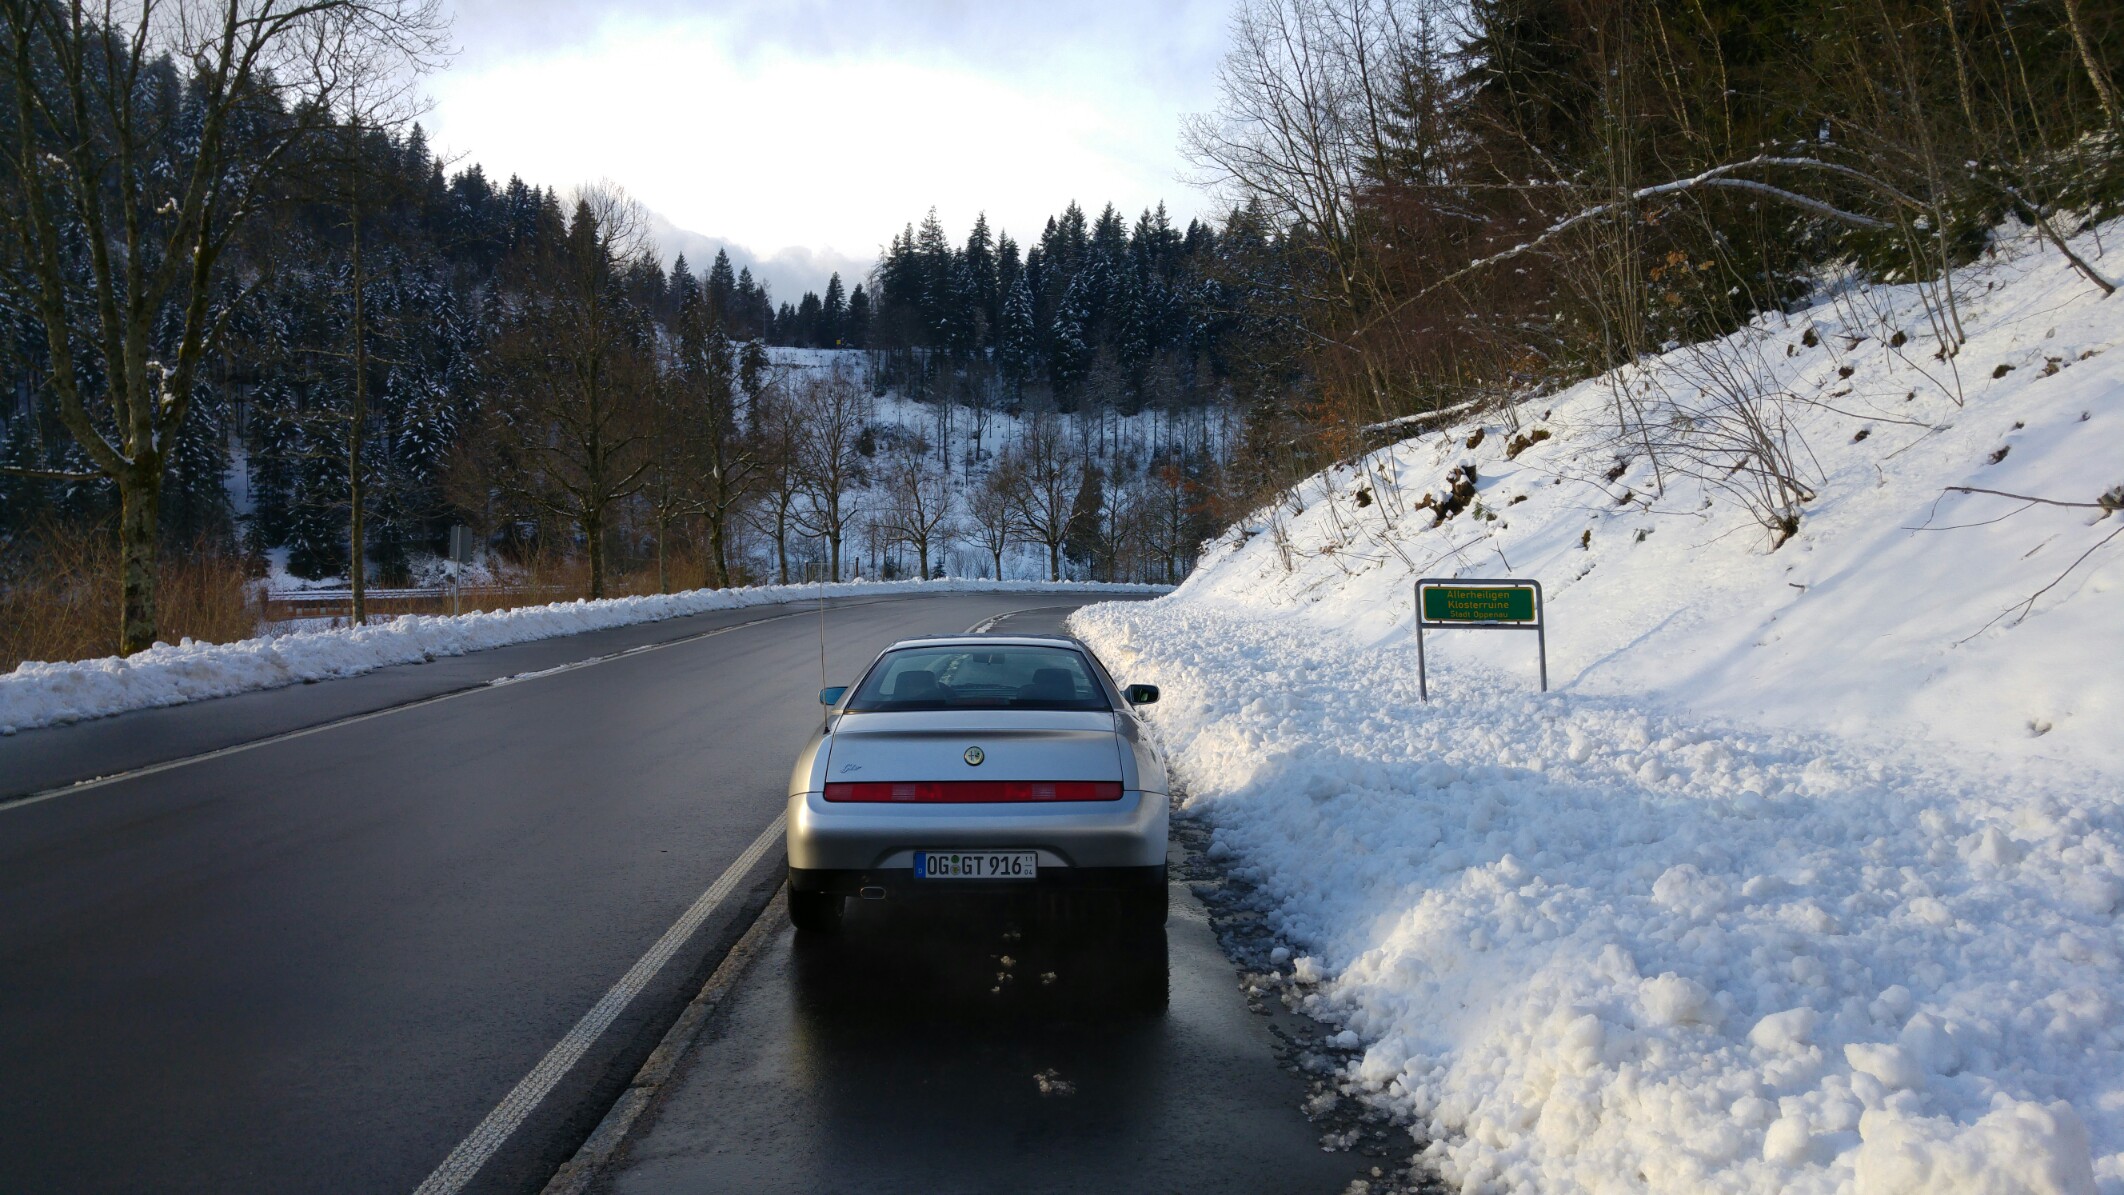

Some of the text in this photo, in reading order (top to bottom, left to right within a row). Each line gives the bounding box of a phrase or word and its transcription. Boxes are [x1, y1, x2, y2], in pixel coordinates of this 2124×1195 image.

[1447, 590, 1510, 601] Allerheiligen
[1448, 600, 1510, 609] Klosterruine
[1450, 610, 1509, 619] Stadt Oppenau
[927, 856, 1022, 875] OG GT 916
